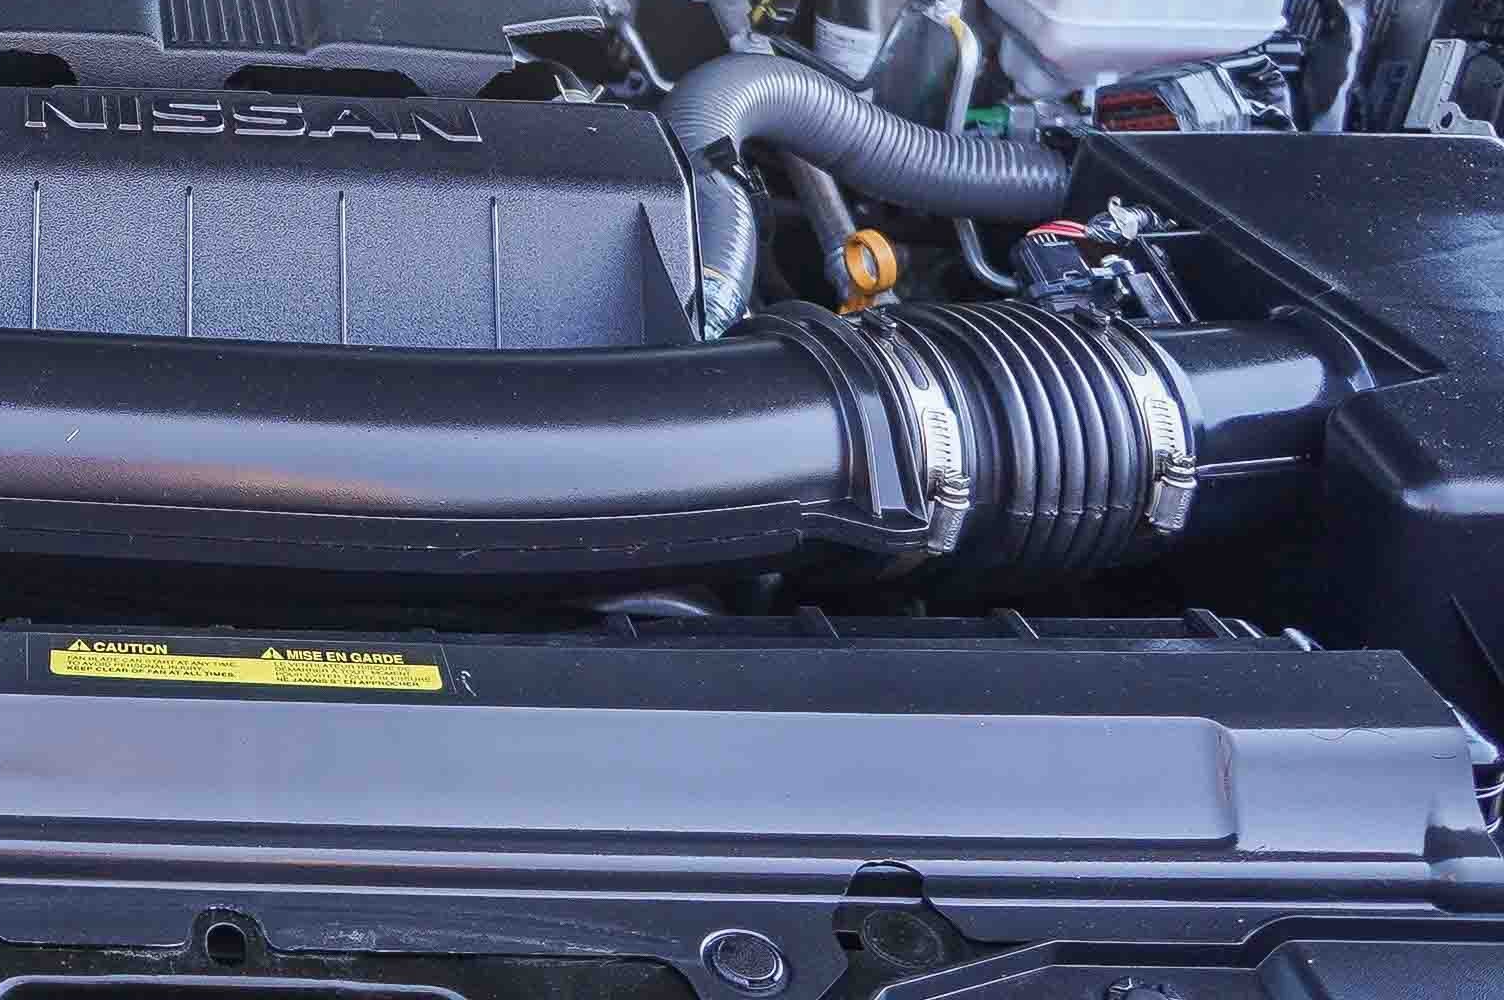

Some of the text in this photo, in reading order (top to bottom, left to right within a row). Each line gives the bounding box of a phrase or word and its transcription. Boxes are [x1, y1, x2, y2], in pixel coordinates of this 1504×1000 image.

[23, 94, 483, 143] NISSAN
[93, 641, 168, 655] CAUTION
[286, 649, 404, 665] MISE EN GARDE
